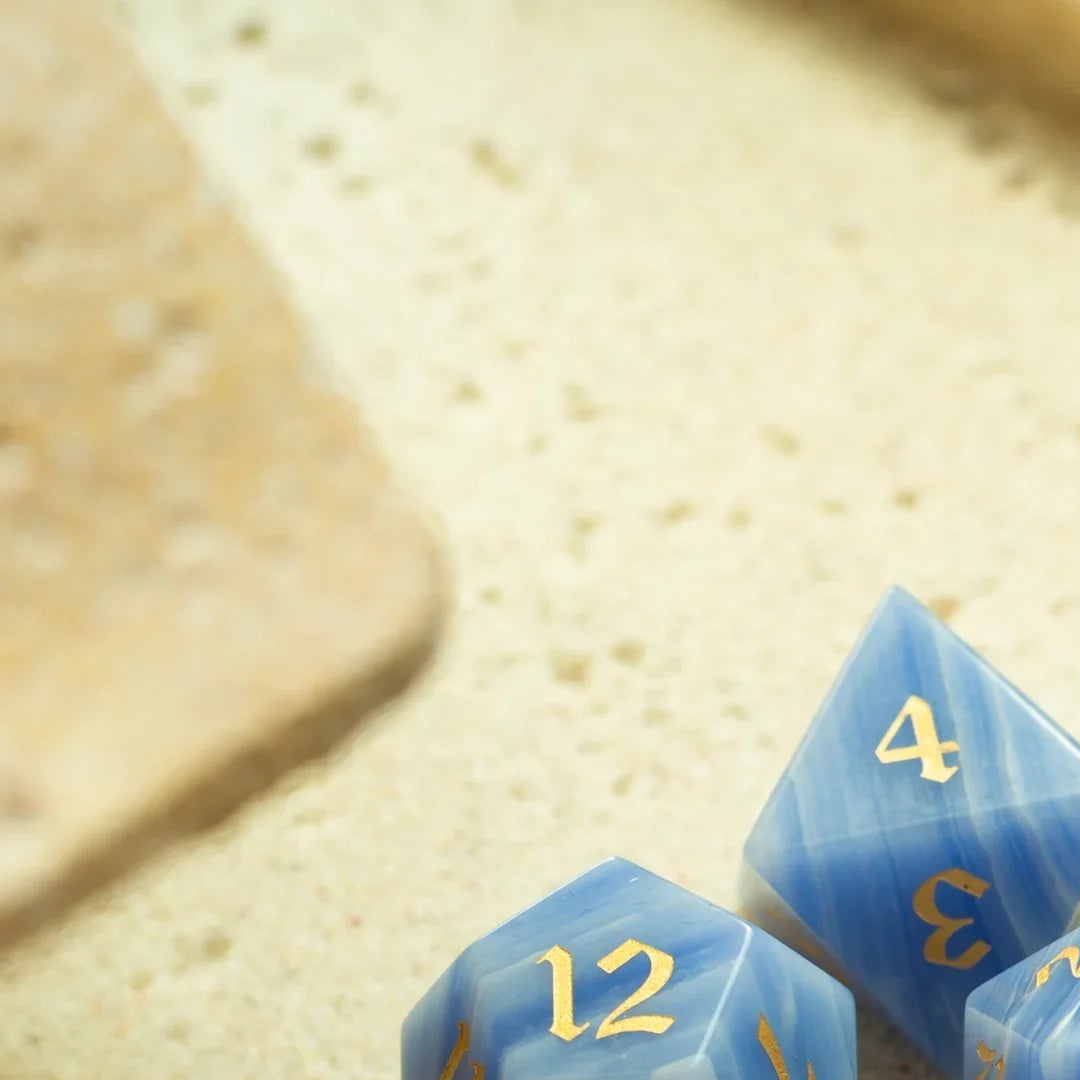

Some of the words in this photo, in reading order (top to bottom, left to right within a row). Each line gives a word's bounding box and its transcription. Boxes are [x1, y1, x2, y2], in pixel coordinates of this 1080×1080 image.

[875, 695, 960, 784] 4
[911, 868, 992, 970] 3
[536, 938, 675, 1041] 12
